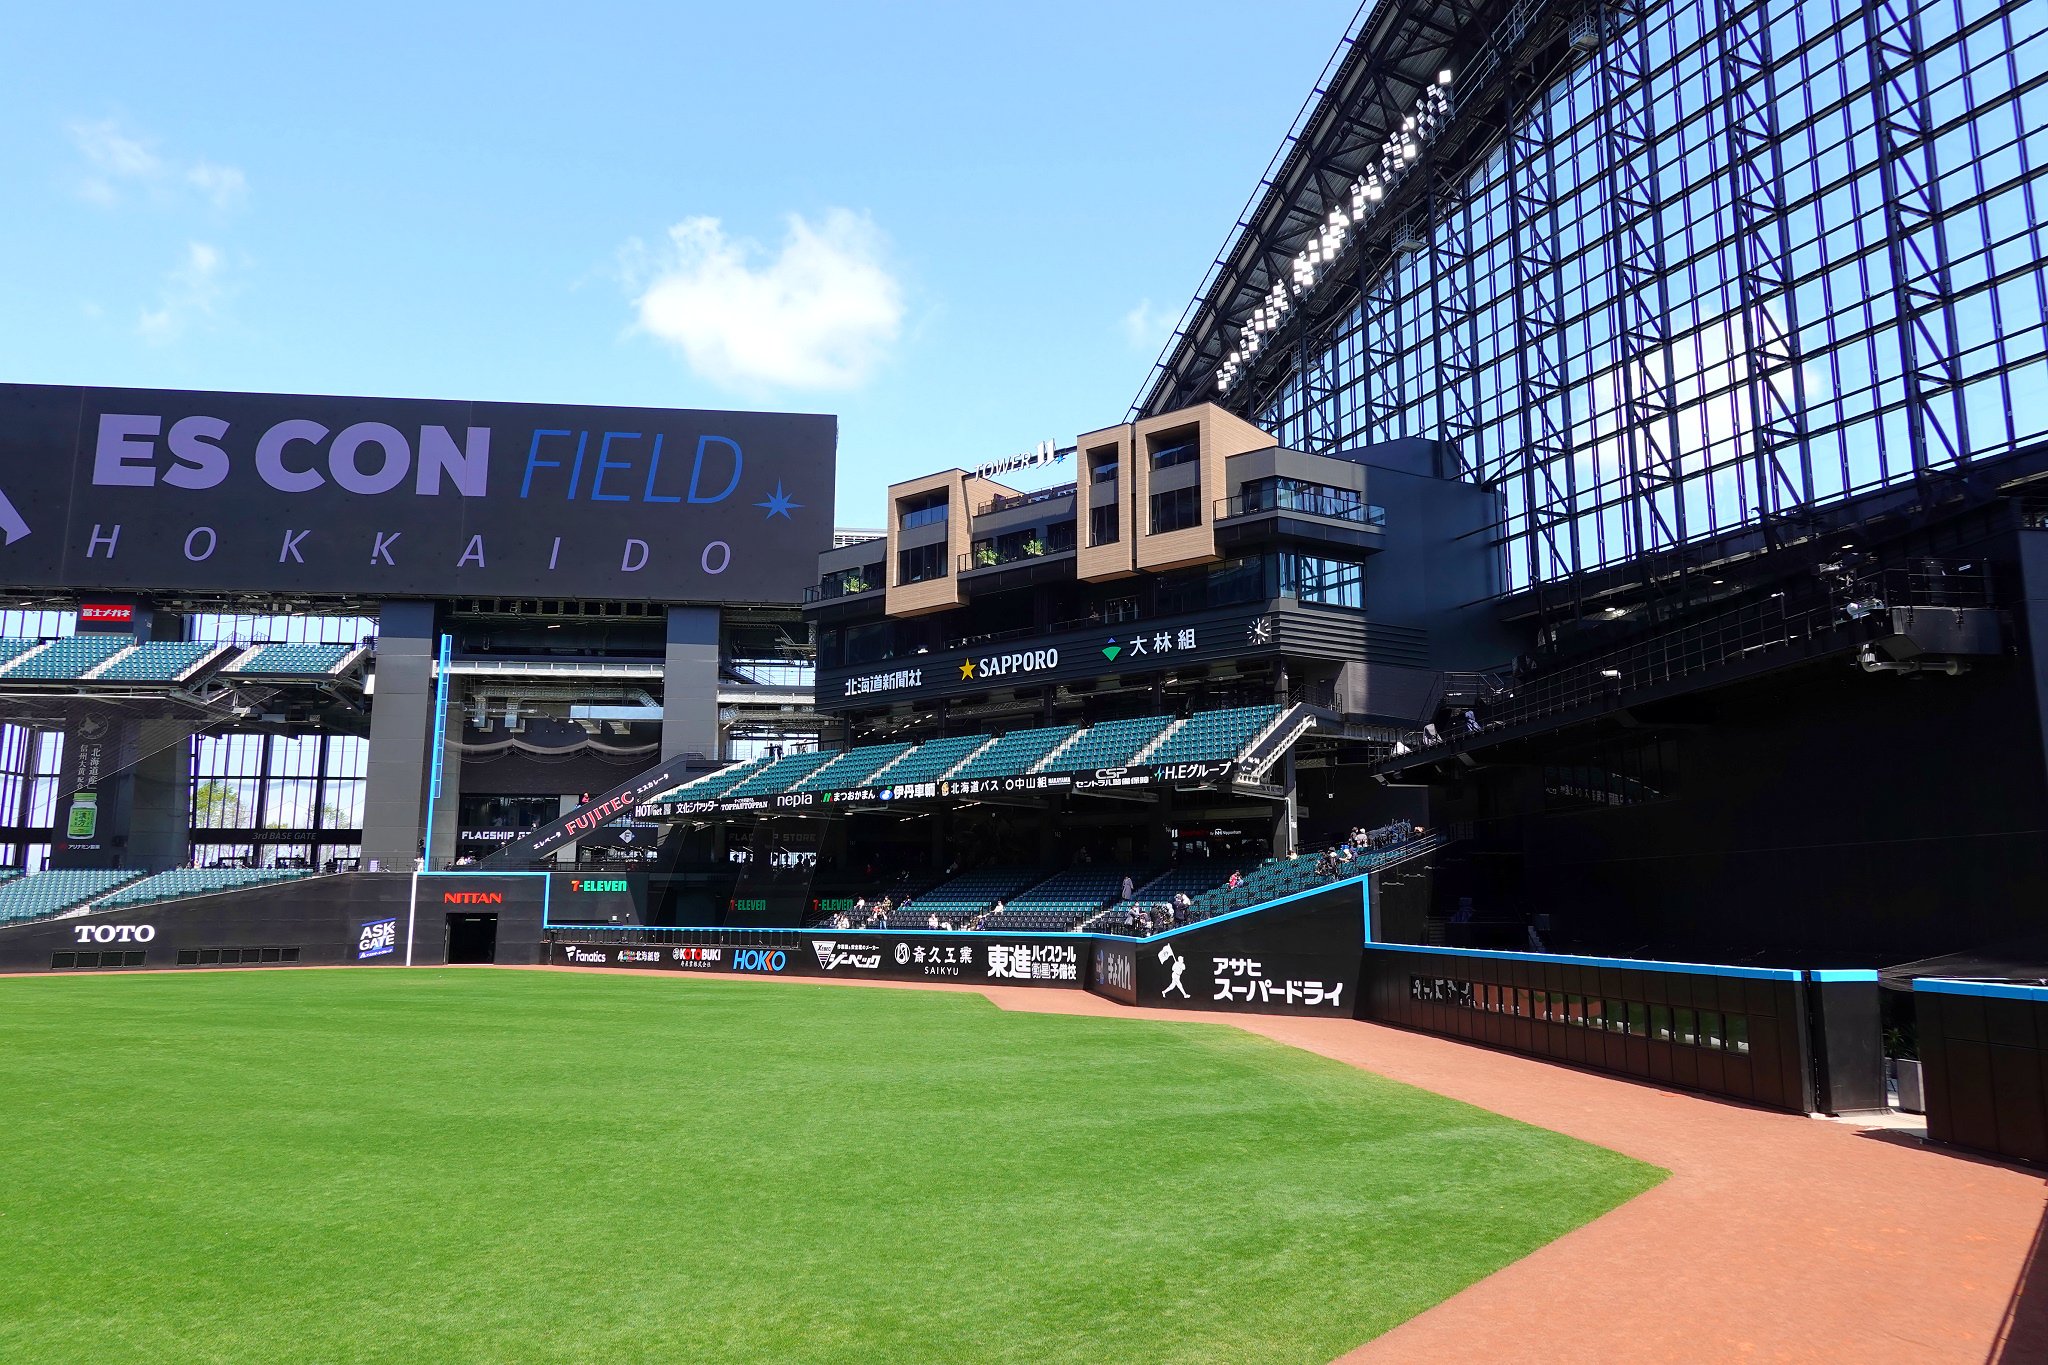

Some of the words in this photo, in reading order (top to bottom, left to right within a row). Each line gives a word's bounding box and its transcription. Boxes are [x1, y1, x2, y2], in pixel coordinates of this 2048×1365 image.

[92, 413, 231, 490] ES
[255, 419, 491, 497] CON
[519, 429, 744, 504] FIELD
[975, 452, 1031, 482] TOWER
[86, 524, 732, 575] HOKKAIDO
[1129, 628, 1197, 657] 大林組
[979, 648, 1059, 678] SAPPORO
[844, 668, 922, 696] 北海道新聞社
[1095, 767, 1128, 779] CSP
[636, 773, 670, 795] エスカレータ
[950, 780, 999, 795] 北海道バス
[776, 792, 813, 808] nepia
[833, 789, 876, 802] まつおかまん
[564, 790, 635, 836] FUJITEC
[252, 831, 268, 840] 3rd
[269, 832, 292, 840] BASE
[294, 832, 317, 840] GATE
[461, 831, 515, 841] FLAGSHIP
[533, 831, 562, 851] エレベータ
[444, 893, 502, 904] NITTAN
[74, 924, 156, 943] TOTO
[360, 921, 396, 941] ASK
[359, 933, 395, 951] GATE
[575, 950, 607, 963] Fanatics
[680, 947, 722, 961] KOTOBUKI
[826, 951, 882, 970] ジーベック
[987, 944, 1032, 979] 東進
[1031, 945, 1077, 964] ハイスクール
[924, 966, 960, 976] SAIKYU
[1031, 962, 1077, 980] 衛星予備校
[1107, 952, 1132, 991] ぎょれん
[1212, 957, 1263, 978] アサヒ
[1213, 978, 1344, 1008] スーパードライ
